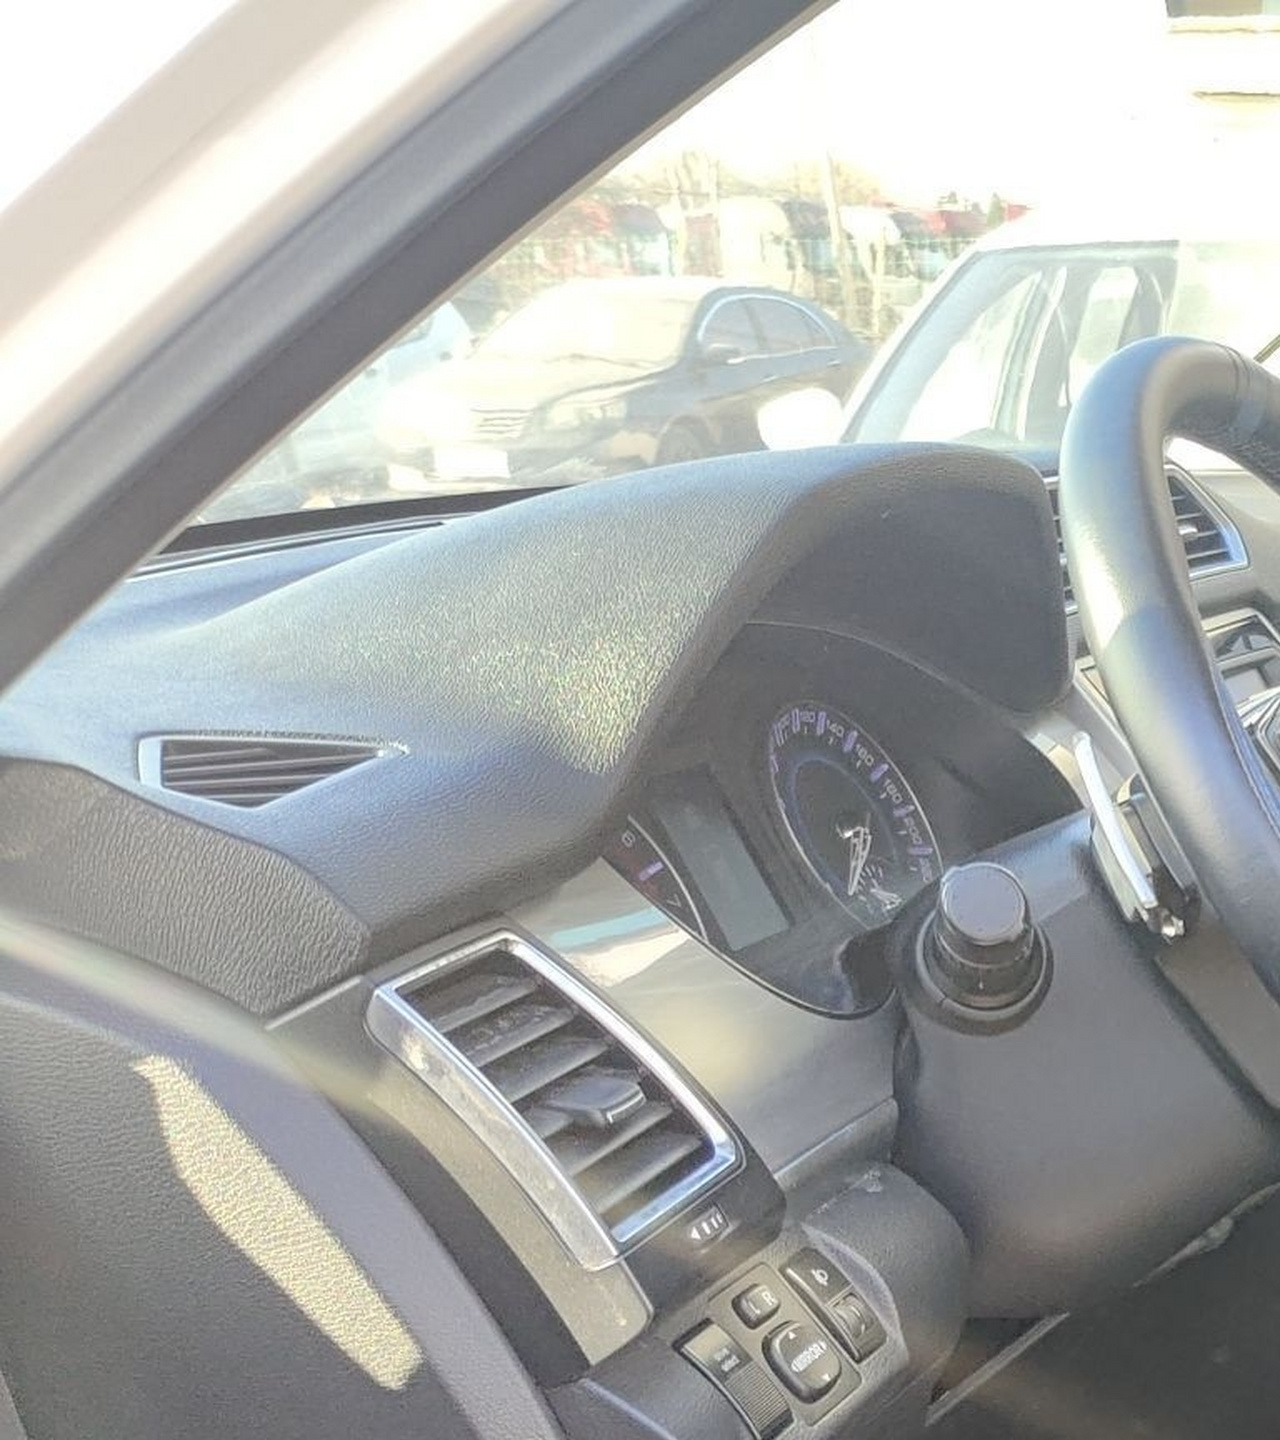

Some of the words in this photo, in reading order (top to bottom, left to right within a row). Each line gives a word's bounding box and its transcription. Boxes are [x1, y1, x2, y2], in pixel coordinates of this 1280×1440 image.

[826, 719, 845, 737] 140
[855, 744, 875, 767] 160
[883, 778, 903, 804] 180
[904, 816, 923, 845] 200
[761, 1291, 779, 1306] R
